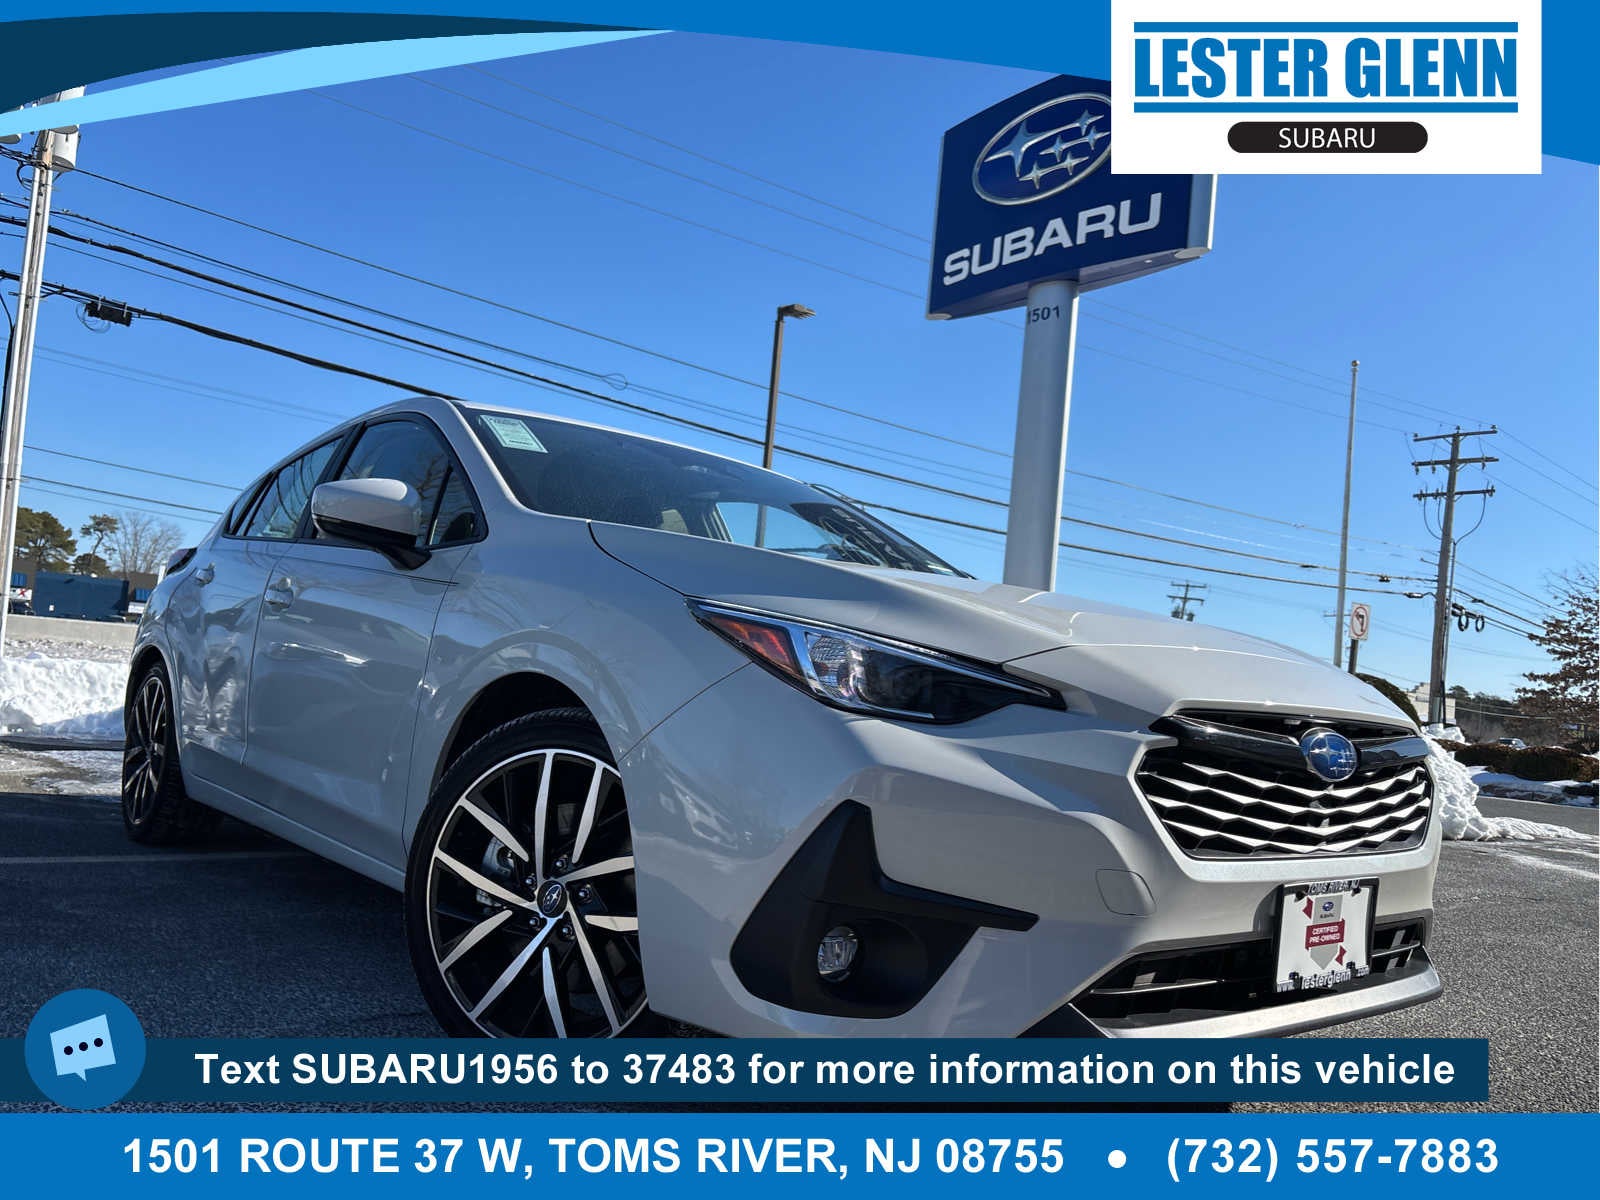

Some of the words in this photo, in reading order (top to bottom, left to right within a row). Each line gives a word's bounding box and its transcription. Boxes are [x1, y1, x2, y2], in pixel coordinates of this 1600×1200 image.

[943, 192, 1163, 286] SUBARU
[1312, 926, 1339, 935] CERTIFIED
[1309, 933, 1340, 944] PRE-OWNED
[1301, 970, 1352, 989] lesterglenn
